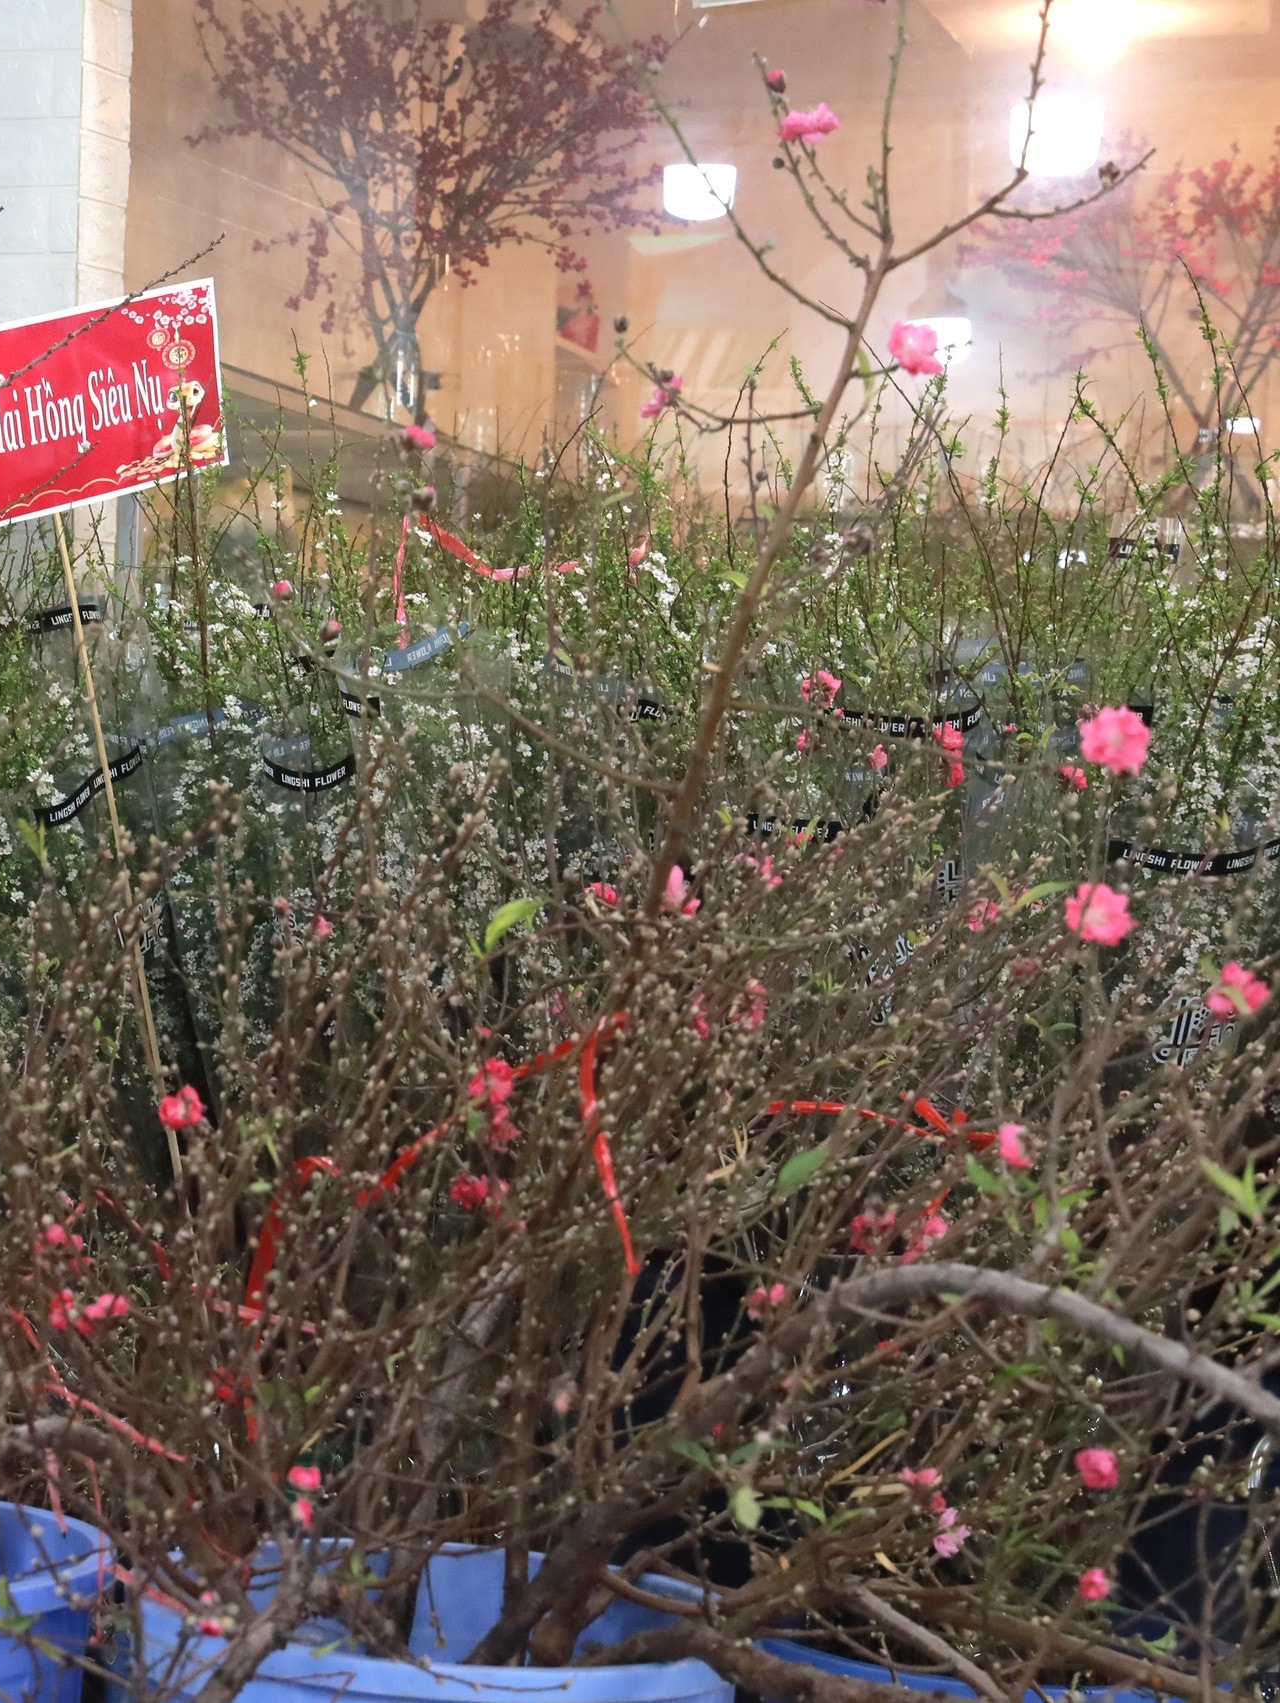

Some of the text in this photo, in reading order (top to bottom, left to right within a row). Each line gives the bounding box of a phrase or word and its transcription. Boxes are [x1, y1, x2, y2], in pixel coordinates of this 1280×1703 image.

[23, 376, 90, 454] Hồng
[87, 366, 134, 431] Siêu
[131, 359, 165, 431] Nụ
[92, 766, 119, 789] LINGHI
[281, 765, 347, 789] LINGSHI FLOWER
